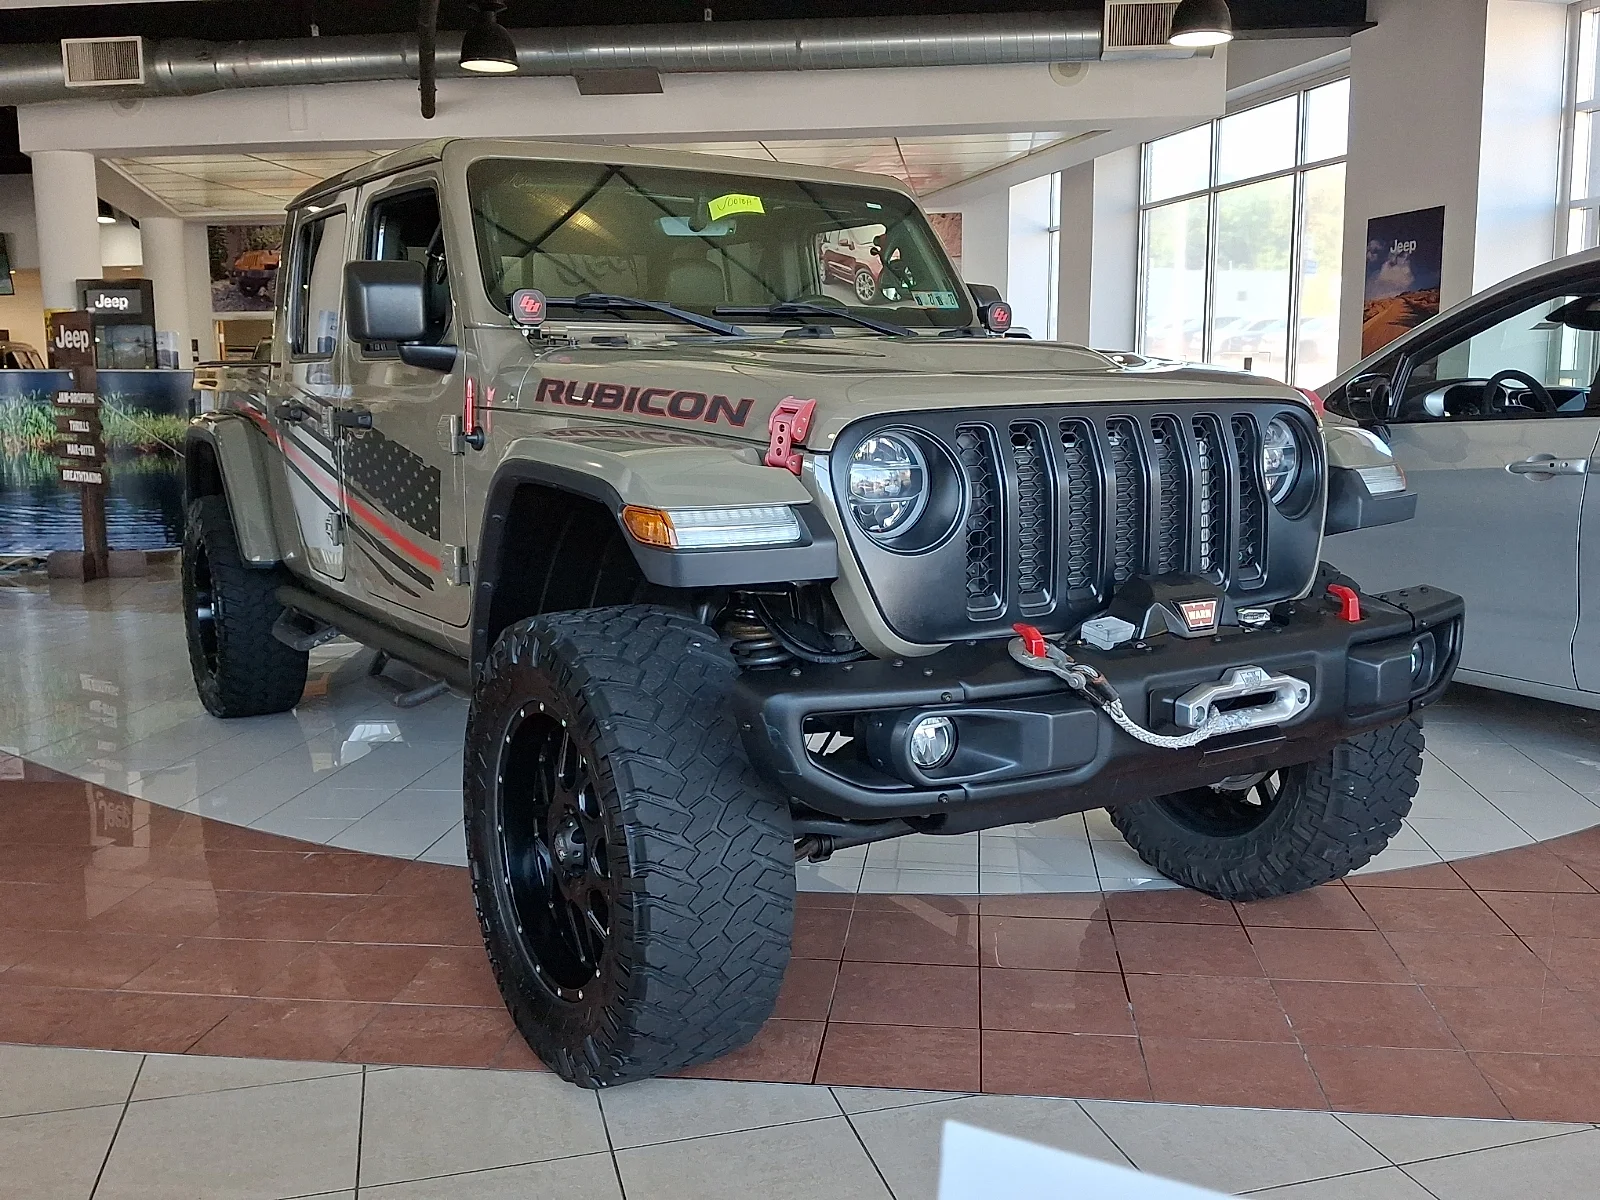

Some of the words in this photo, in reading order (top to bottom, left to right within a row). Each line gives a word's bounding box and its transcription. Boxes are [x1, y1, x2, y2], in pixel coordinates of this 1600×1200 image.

[1390, 239, 1417, 254] Jeep
[94, 293, 129, 311] Jeep
[55, 324, 89, 353] Jeep
[534, 377, 755, 428] RUBICON
[68, 420, 90, 433] THRILLS
[62, 469, 102, 484] BREATHTAKING
[1188, 609, 1212, 620] WARN
